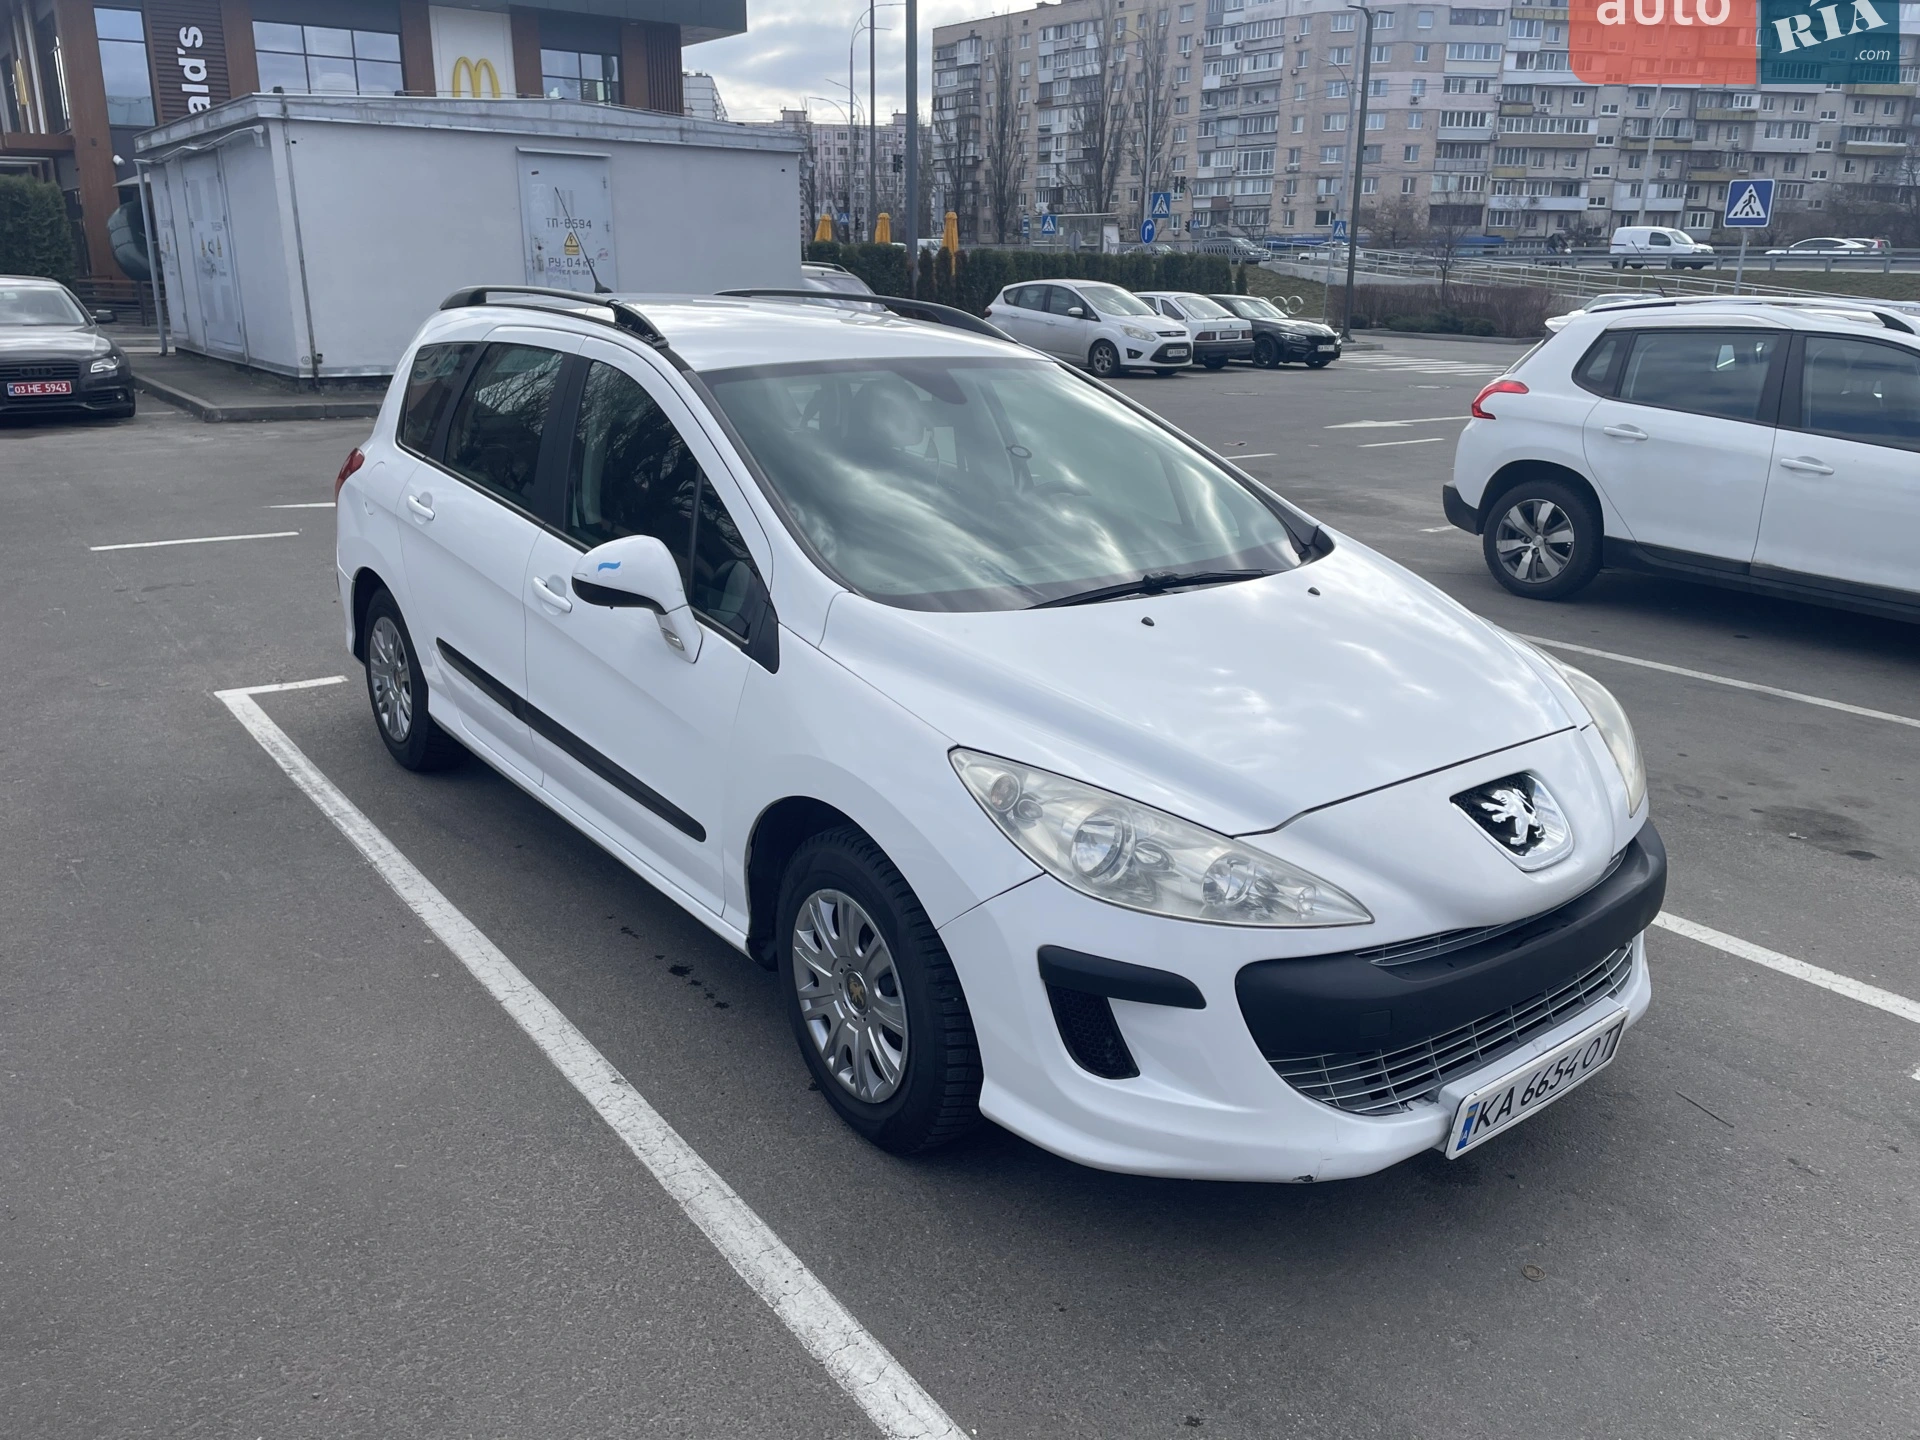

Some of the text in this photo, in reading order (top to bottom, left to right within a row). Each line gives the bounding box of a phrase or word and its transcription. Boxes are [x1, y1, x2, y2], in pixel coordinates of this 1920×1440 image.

[28, 384, 42, 393] HE
[45, 383, 67, 392] 5943
[1473, 1023, 1621, 1135] KA 6654 OT
